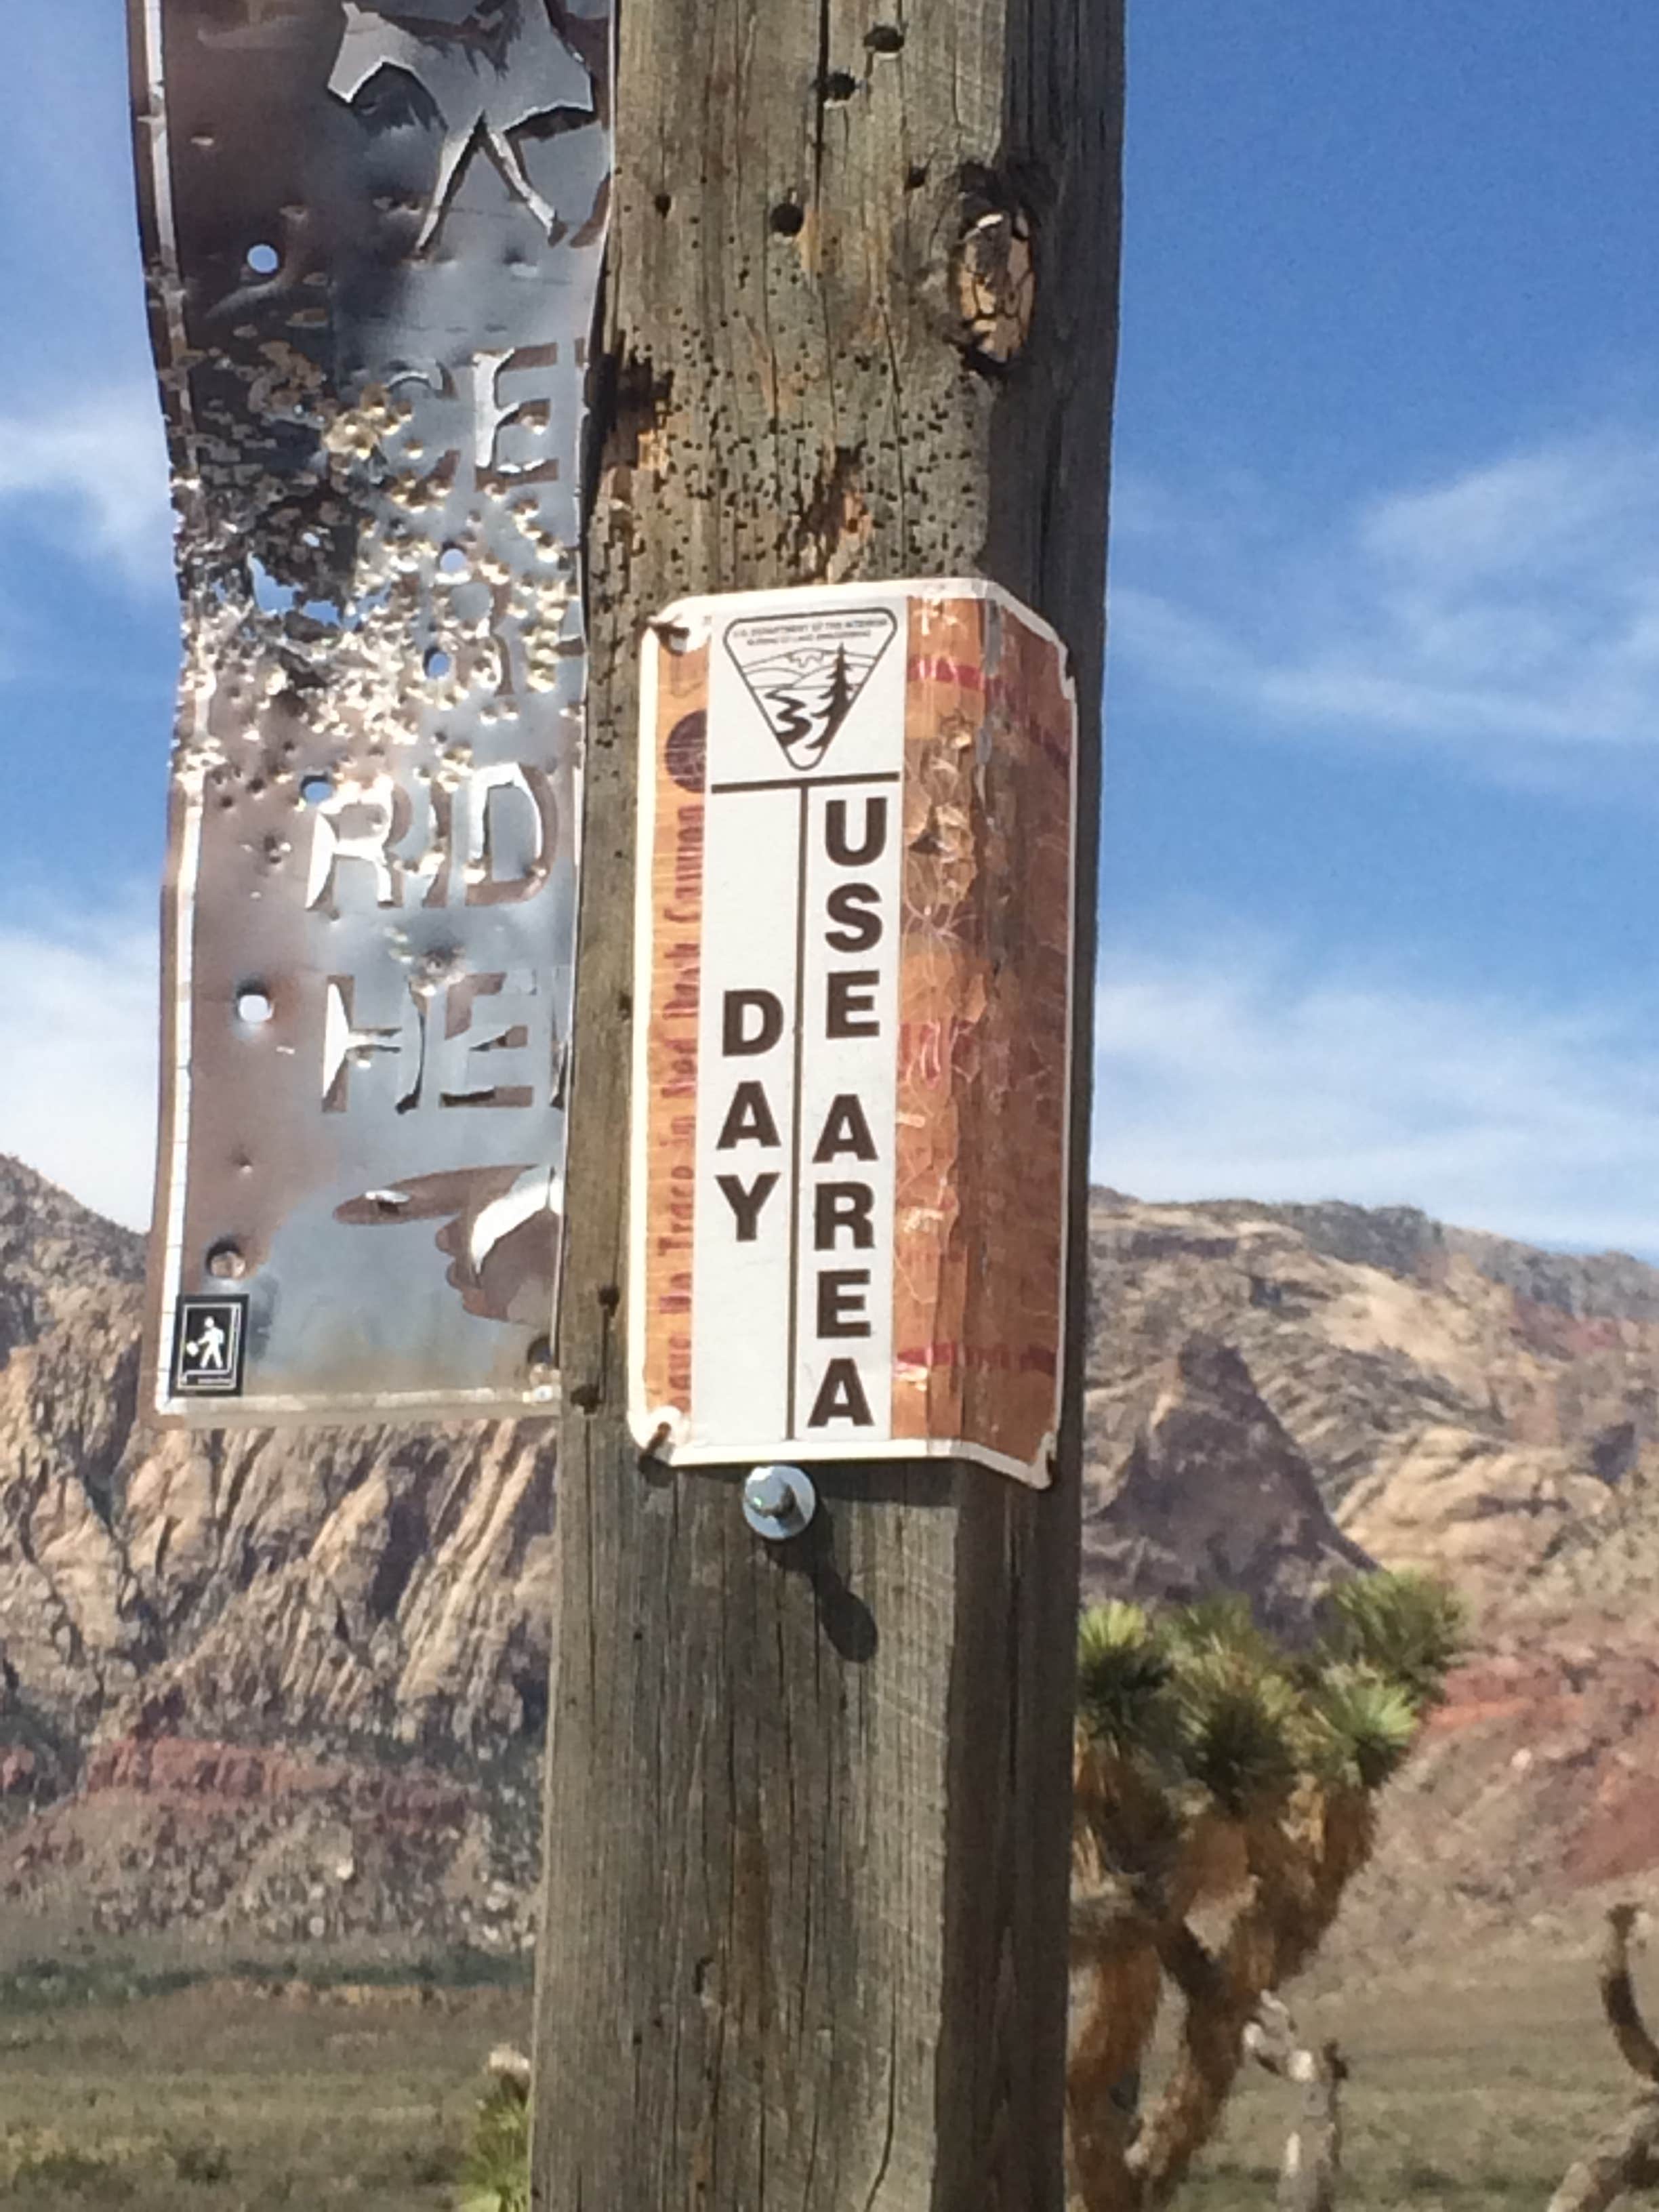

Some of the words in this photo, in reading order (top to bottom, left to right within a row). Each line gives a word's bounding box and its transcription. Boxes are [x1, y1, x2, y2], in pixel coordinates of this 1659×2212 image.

[825, 798, 886, 1039] USE
[716, 989, 783, 1242] DAY
[808, 1094, 878, 1427] AREA
